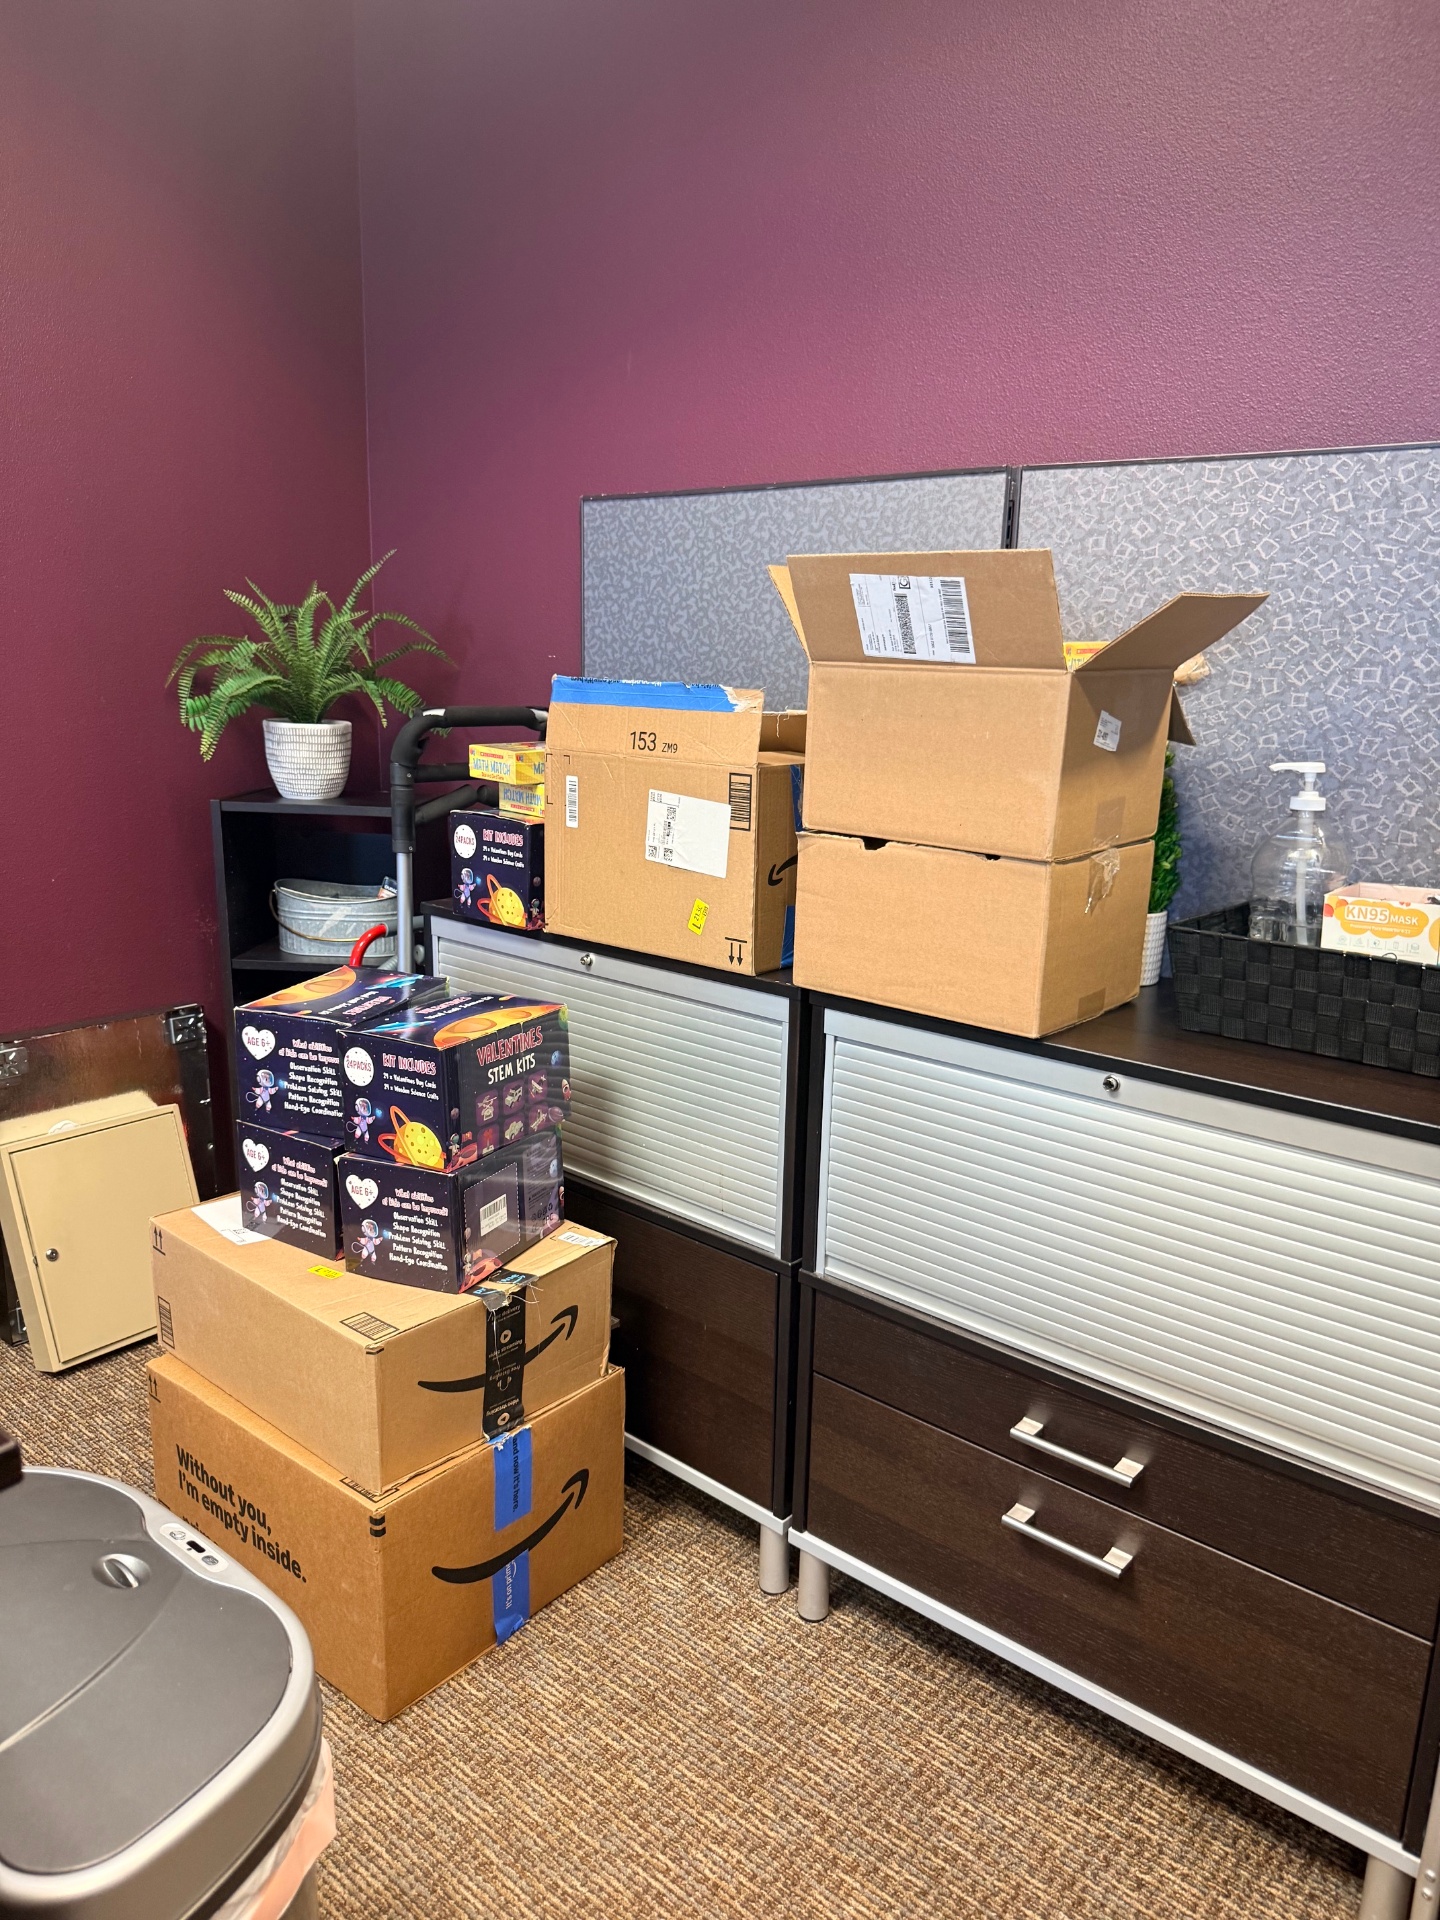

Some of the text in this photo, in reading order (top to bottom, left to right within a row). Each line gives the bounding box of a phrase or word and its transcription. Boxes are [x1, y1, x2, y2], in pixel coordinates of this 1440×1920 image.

[630, 731, 678, 753] 153 ZM9
[491, 760, 510, 776] MATCH
[483, 829, 523, 846] KIT INCLUDES
[1346, 906, 1418, 925] KN95 MASK
[247, 1037, 270, 1047] AGE 6+
[476, 1026, 543, 1066] VALENTINES
[290, 1062, 321, 1073] Observation
[347, 1060, 371, 1072] 24PACKS
[383, 1053, 436, 1075] KIT INCLUDES
[488, 1053, 535, 1084] STEM KITS
[289, 1072, 338, 1086] Shape Recognition
[393, 1074, 415, 1084] Valentines
[416, 1078, 424, 1088] Day
[425, 1080, 436, 1088] Cards
[288, 1092, 339, 1106] Pattern Recognition
[394, 1085, 410, 1094] Wooden
[411, 1088, 426, 1098] Science
[427, 1092, 439, 1100] Crafts
[247, 1149, 265, 1160] AGE 6+
[351, 1185, 373, 1196] AGE 6+
[393, 1212, 424, 1224] Observation
[393, 1222, 440, 1238] Shape Recognition
[392, 1243, 443, 1259] Pattern Recognition
[416, 1258, 448, 1271] Coordination
[176, 1443, 235, 1507] Without
[238, 1495, 272, 1536] you,
[178, 1469, 200, 1503] I'm
[202, 1493, 249, 1543] empty
[252, 1525, 307, 1583] inside.
[506, 1584, 512, 1595] on
